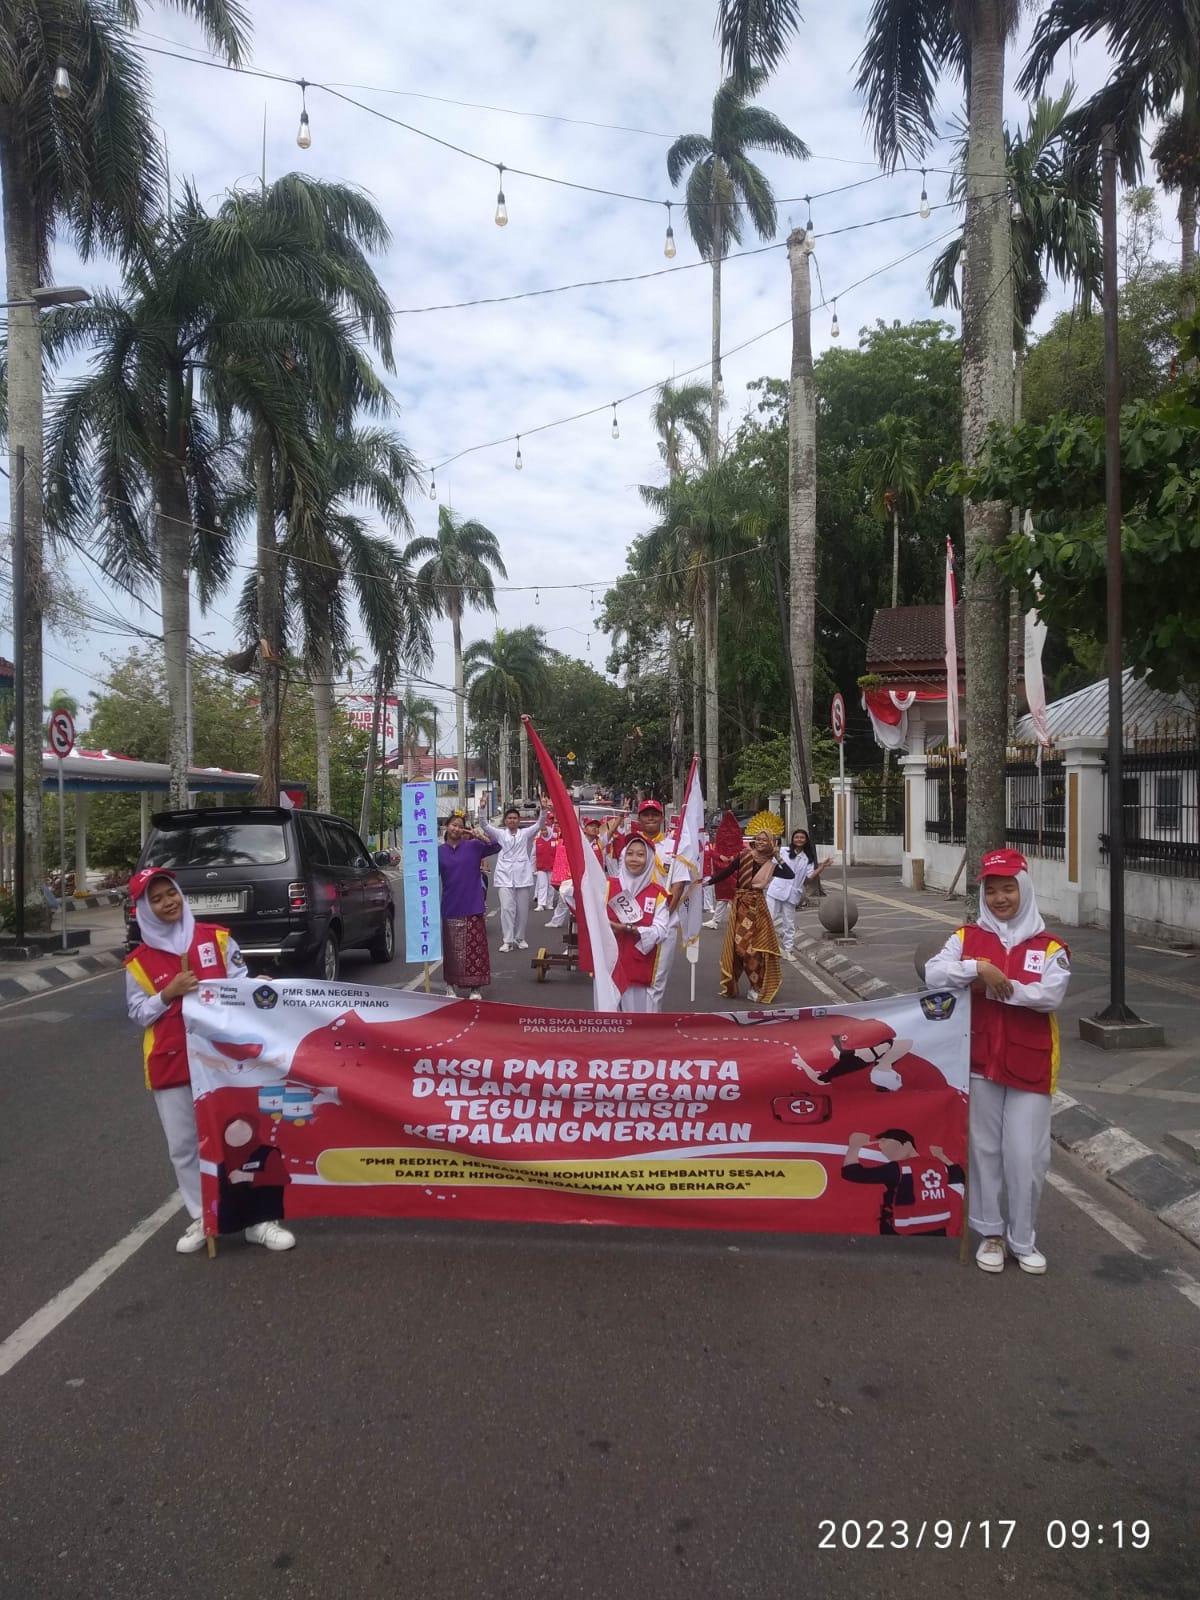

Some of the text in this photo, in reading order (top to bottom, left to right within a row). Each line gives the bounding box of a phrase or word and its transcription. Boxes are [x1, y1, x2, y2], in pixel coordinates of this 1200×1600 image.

[616, 895, 634, 916] 022
[1027, 963, 1042, 972] PMI
[282, 988, 303, 997] PMR
[305, 988, 326, 997] SMA
[328, 989, 363, 998] NEGERI
[283, 999, 389, 1008] KOTA PANGKALPINANG
[523, 1025, 625, 1033] PANGKALPINANG
[413, 1058, 739, 1081] AKSI PMR REDIKTA
[412, 1077, 741, 1101] DALAM MEMEGANG
[444, 1099, 709, 1121] TEGUH PRINSIP
[403, 1121, 752, 1144] KEPALANGMERAHAN
[399, 1158, 458, 1167] REDIKTA
[553, 1169, 645, 1179] KOMUNIKASI
[648, 1169, 725, 1178] MEMBANTU
[728, 1169, 786, 1178] SESAMA
[395, 1169, 430, 1178] DARI
[433, 1169, 465, 1178] DIRI
[469, 1171, 524, 1182] HINGGA
[626, 1183, 666, 1192] YANG
[921, 1188, 945, 1200] PMI
